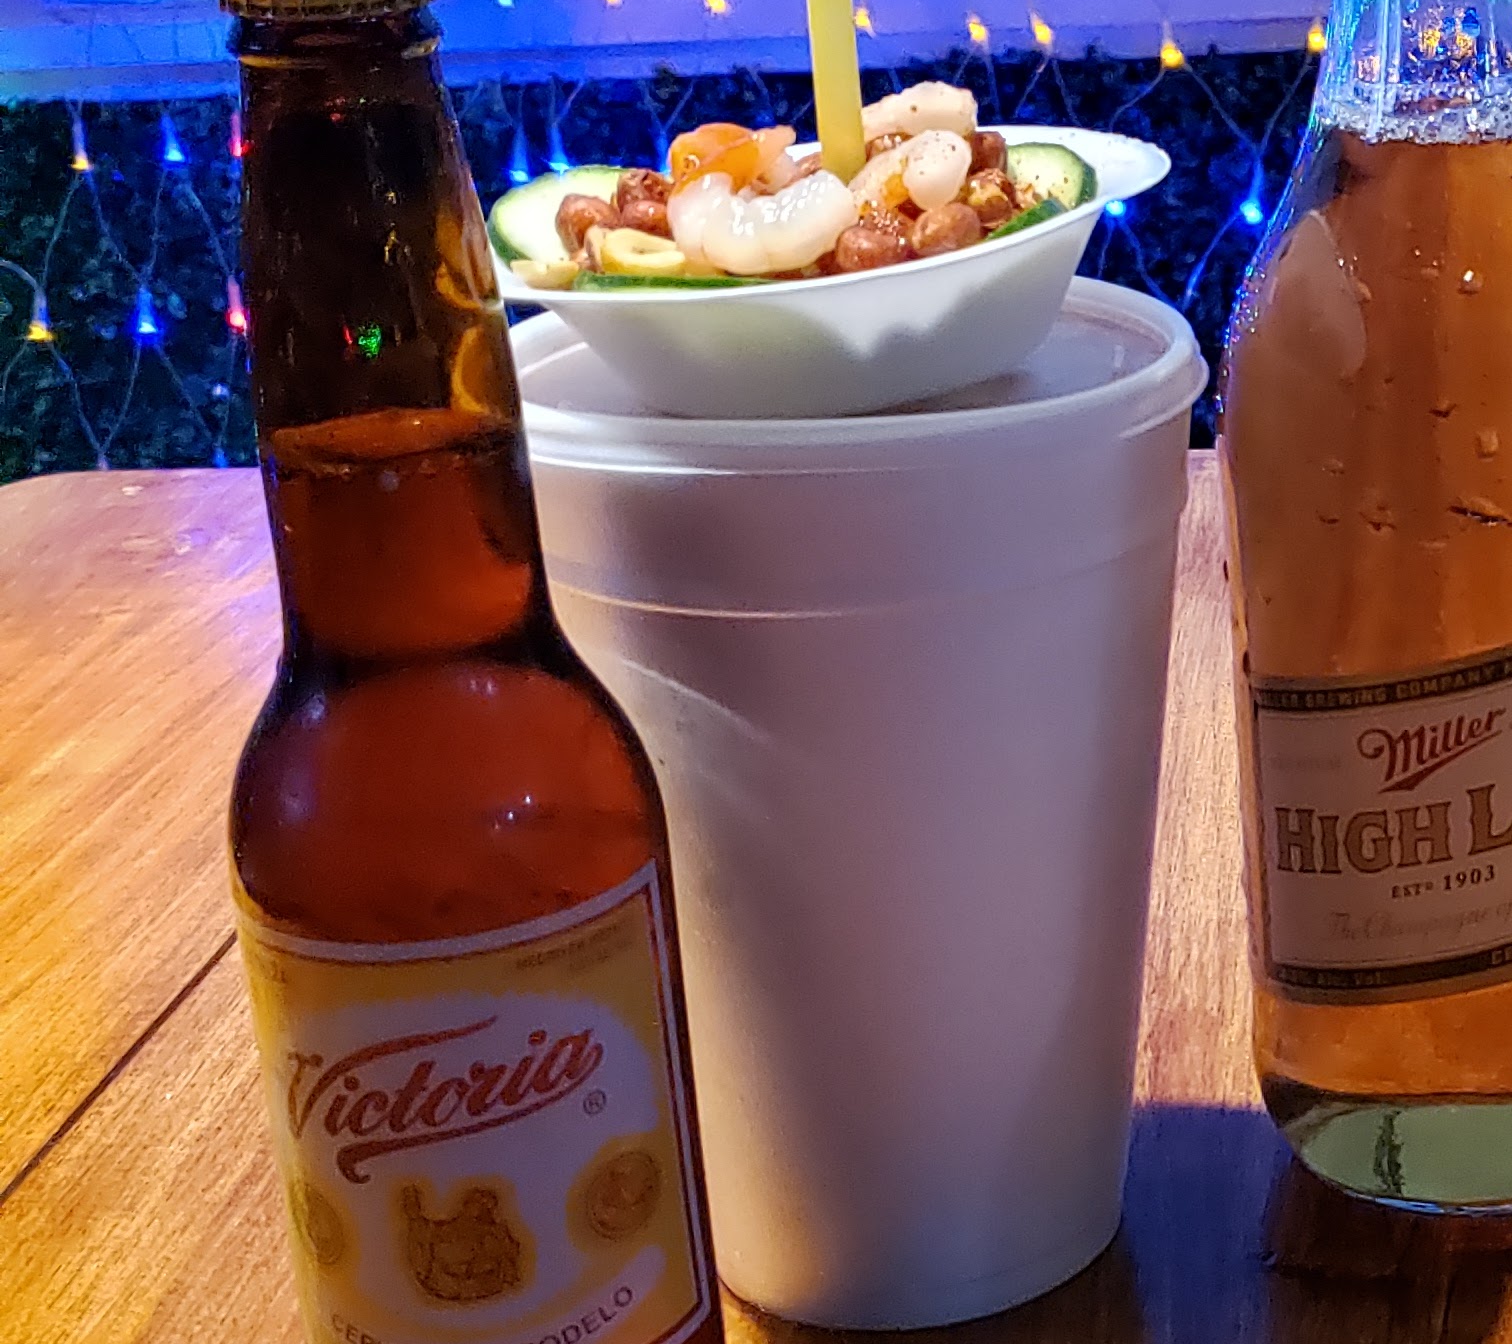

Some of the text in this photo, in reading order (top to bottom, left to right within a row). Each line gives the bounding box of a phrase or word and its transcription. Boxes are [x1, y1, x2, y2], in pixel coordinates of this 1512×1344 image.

[1397, 665, 1494, 700] COMPANY
[1357, 708, 1507, 793] Miller
[1275, 801, 1453, 874] HIGH
[1442, 863, 1496, 892] 1903
[288, 1016, 604, 1184] Victoria
